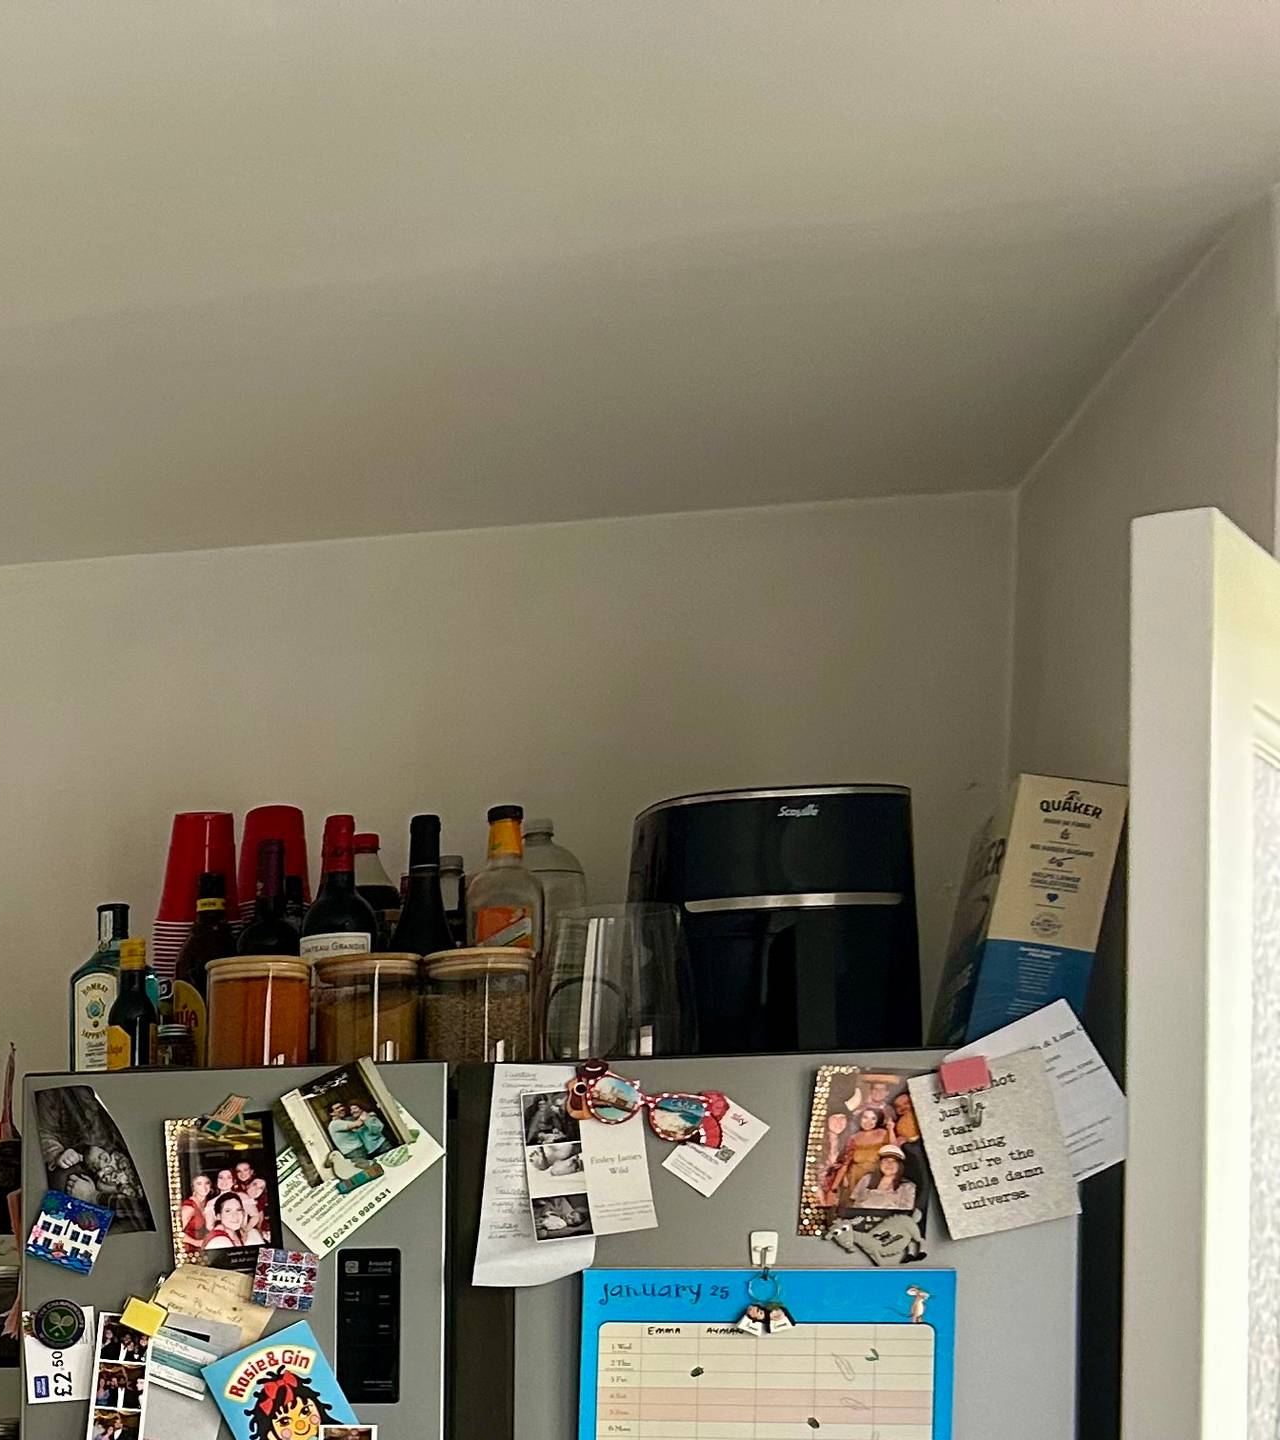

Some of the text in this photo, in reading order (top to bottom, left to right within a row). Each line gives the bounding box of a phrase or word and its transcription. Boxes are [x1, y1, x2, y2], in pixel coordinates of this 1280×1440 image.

[1039, 800, 1103, 819] QUAKER
[939, 1104, 969, 1121] just
[947, 1136, 1007, 1156] darling
[953, 1148, 1035, 1176] you're the
[957, 1165, 1045, 1192] whole damn
[271, 1274, 302, 1284] MALTA
[710, 1284, 730, 1300] 25
[647, 1326, 682, 1336] EMMA
[228, 1349, 311, 1398] Rosie & Gin
